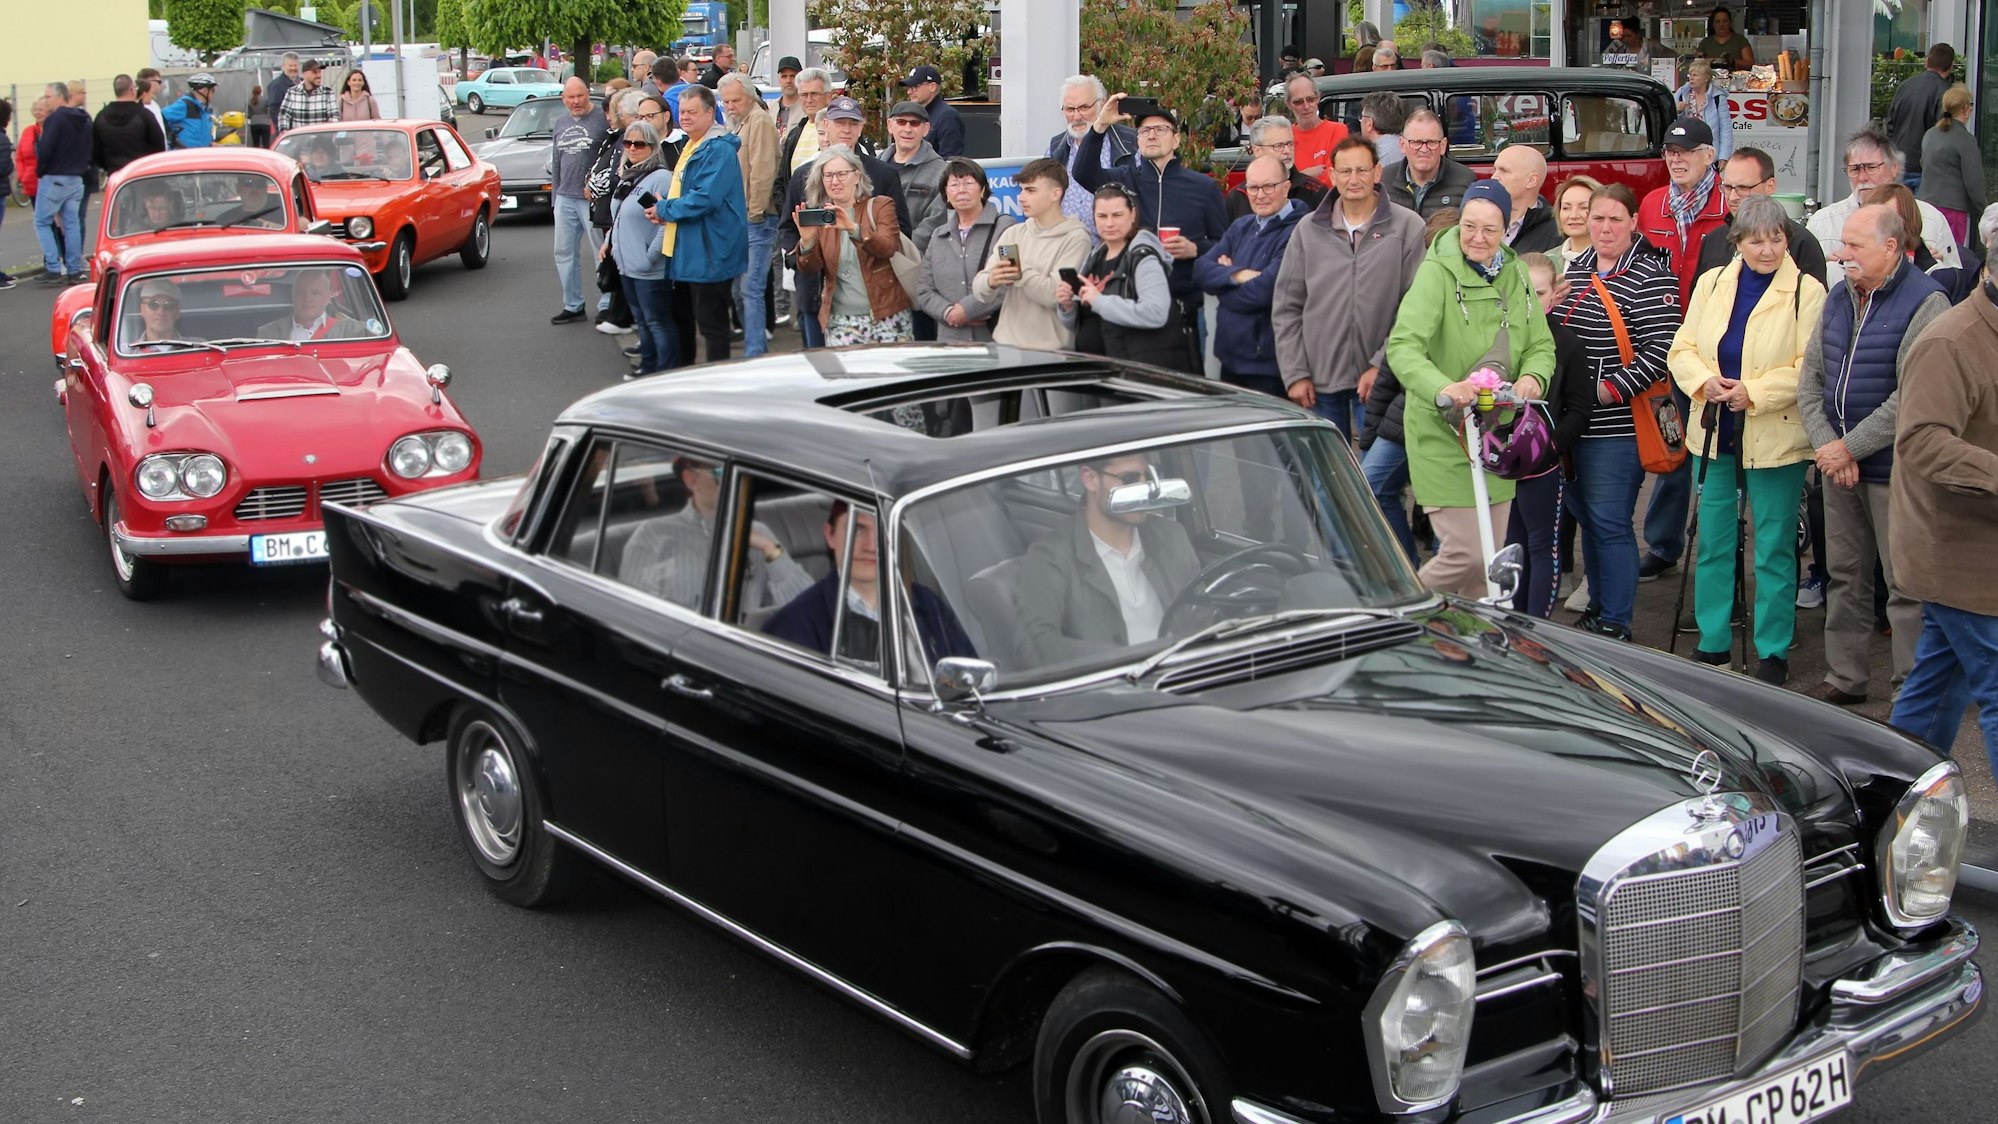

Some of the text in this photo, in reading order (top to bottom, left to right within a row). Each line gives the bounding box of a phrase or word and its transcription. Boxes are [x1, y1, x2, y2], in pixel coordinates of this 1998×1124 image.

[1727, 99, 1767, 120] es
[1732, 121, 1752, 130] Cafe
[988, 176, 1021, 189] KAU
[266, 537, 290, 557] BM
